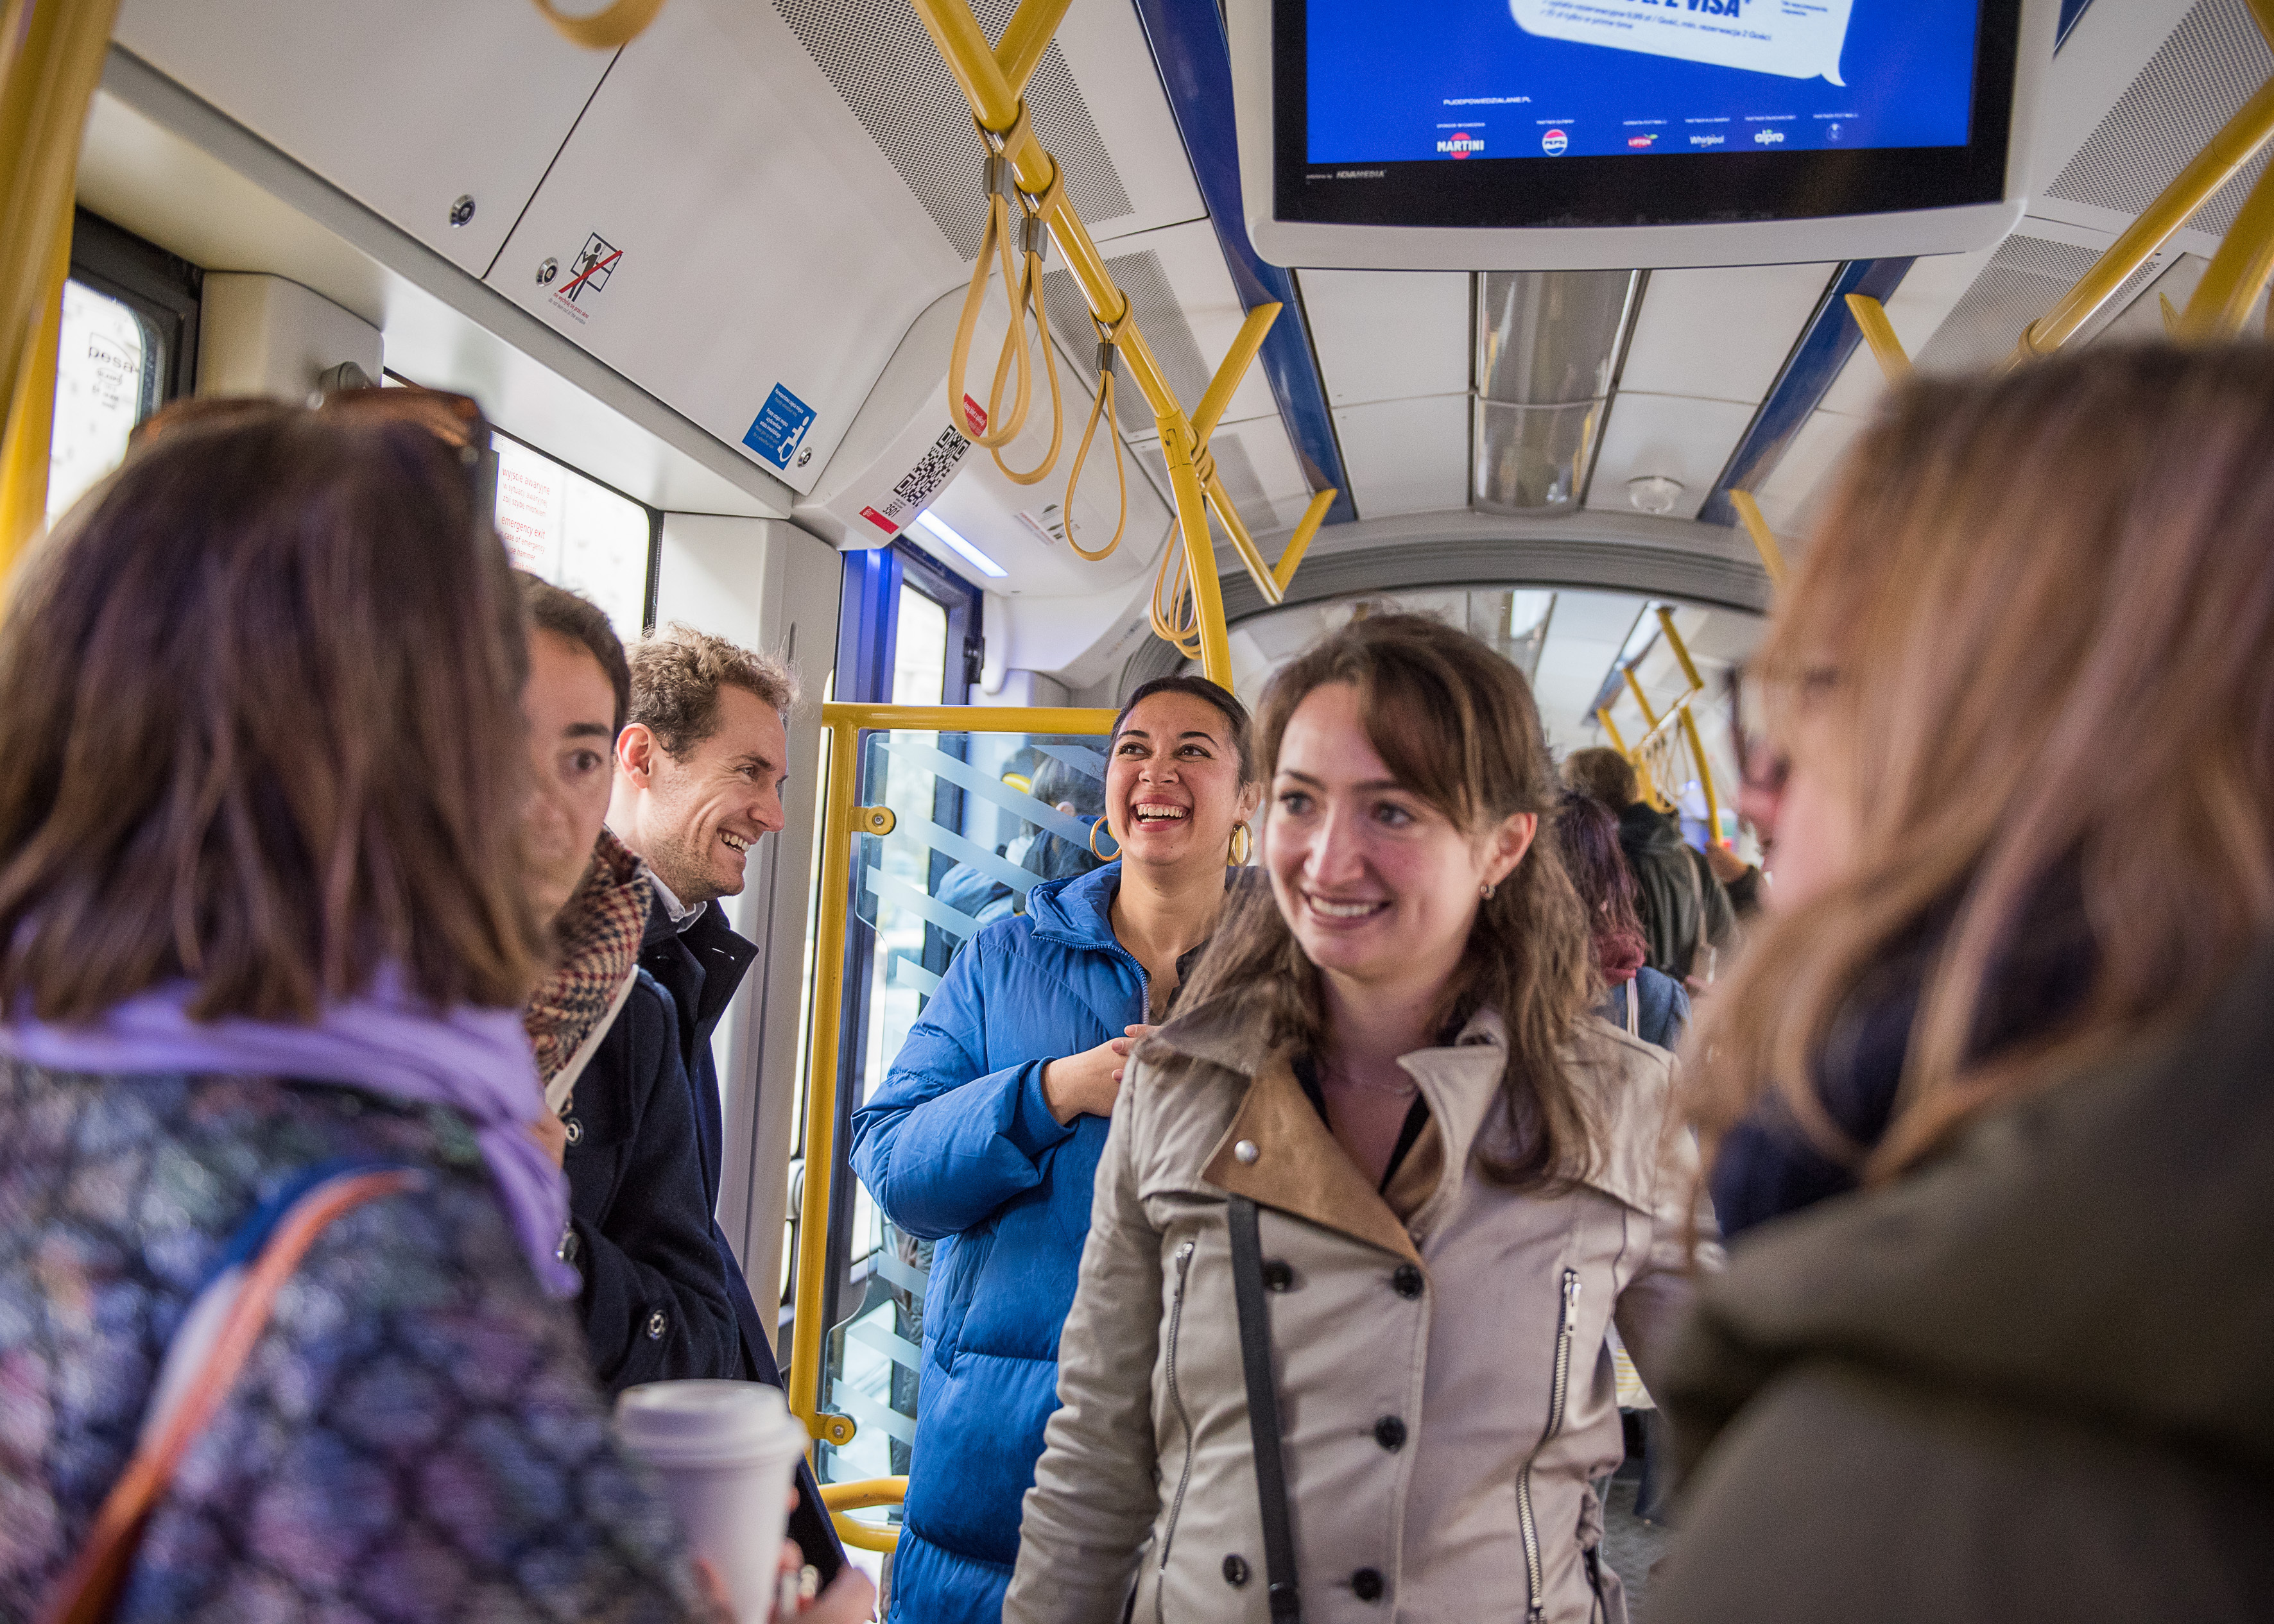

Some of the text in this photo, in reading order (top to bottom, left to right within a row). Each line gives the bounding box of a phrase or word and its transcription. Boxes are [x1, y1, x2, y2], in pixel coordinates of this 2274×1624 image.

[1689, 135, 1725, 146] Whirlpool
[1754, 129, 1784, 145] alpro
[1436, 139, 1485, 152] MARTINI
[89, 346, 133, 373] pesa
[524, 477, 550, 495] awaryjne
[883, 504, 900, 518] 3501
[501, 517, 546, 540] emergency exit
[504, 533, 515, 542] case
[521, 538, 545, 554] emergency
[517, 547, 536, 561] hammer
